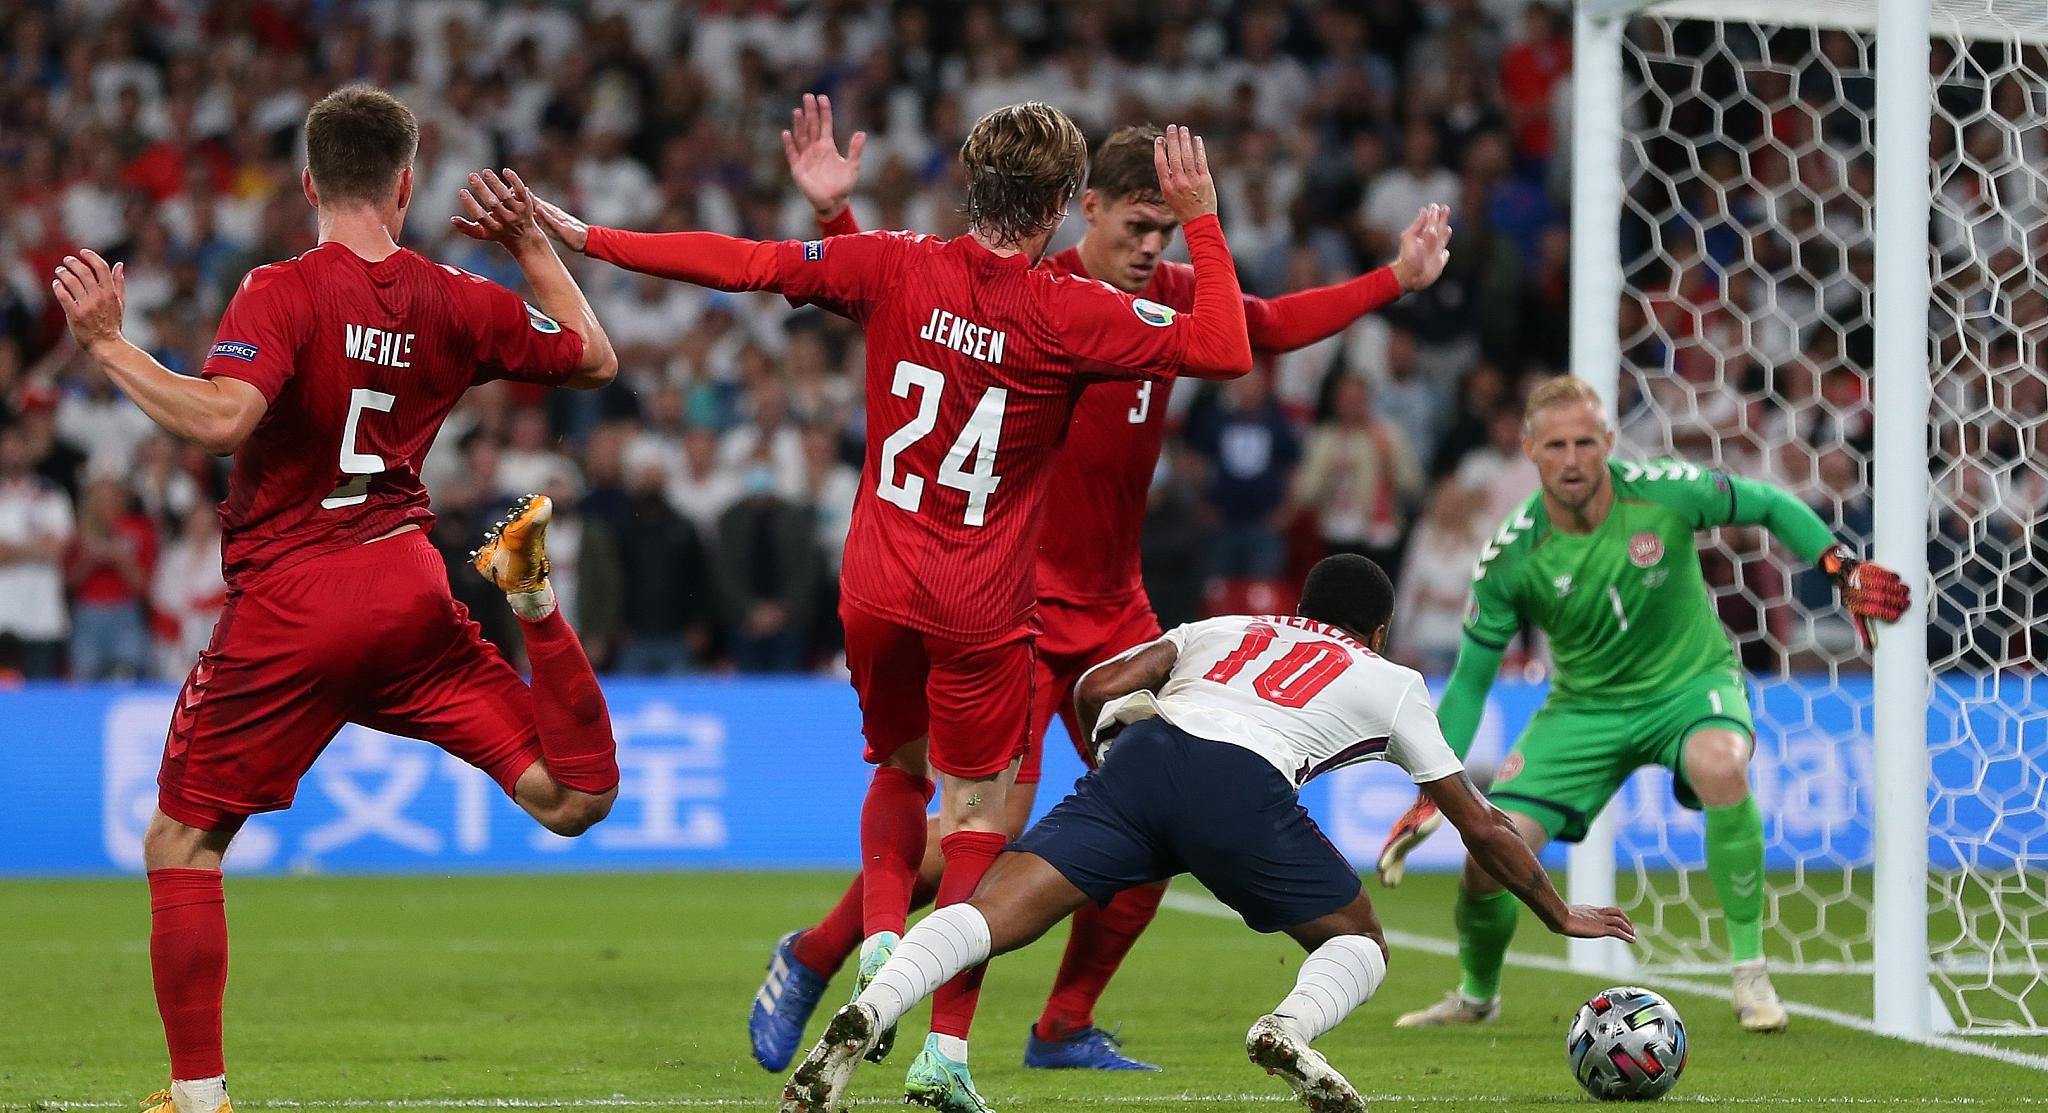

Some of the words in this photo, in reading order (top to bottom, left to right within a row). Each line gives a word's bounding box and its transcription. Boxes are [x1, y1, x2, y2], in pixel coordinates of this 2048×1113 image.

[216, 344, 257, 358] RESPECT
[920, 308, 1006, 364] JENSEN
[320, 388, 396, 510] 5
[876, 360, 1008, 527] 24
[1608, 584, 1628, 632] 1
[1201, 622, 1355, 710] 10
[1708, 689, 1723, 715] 1
